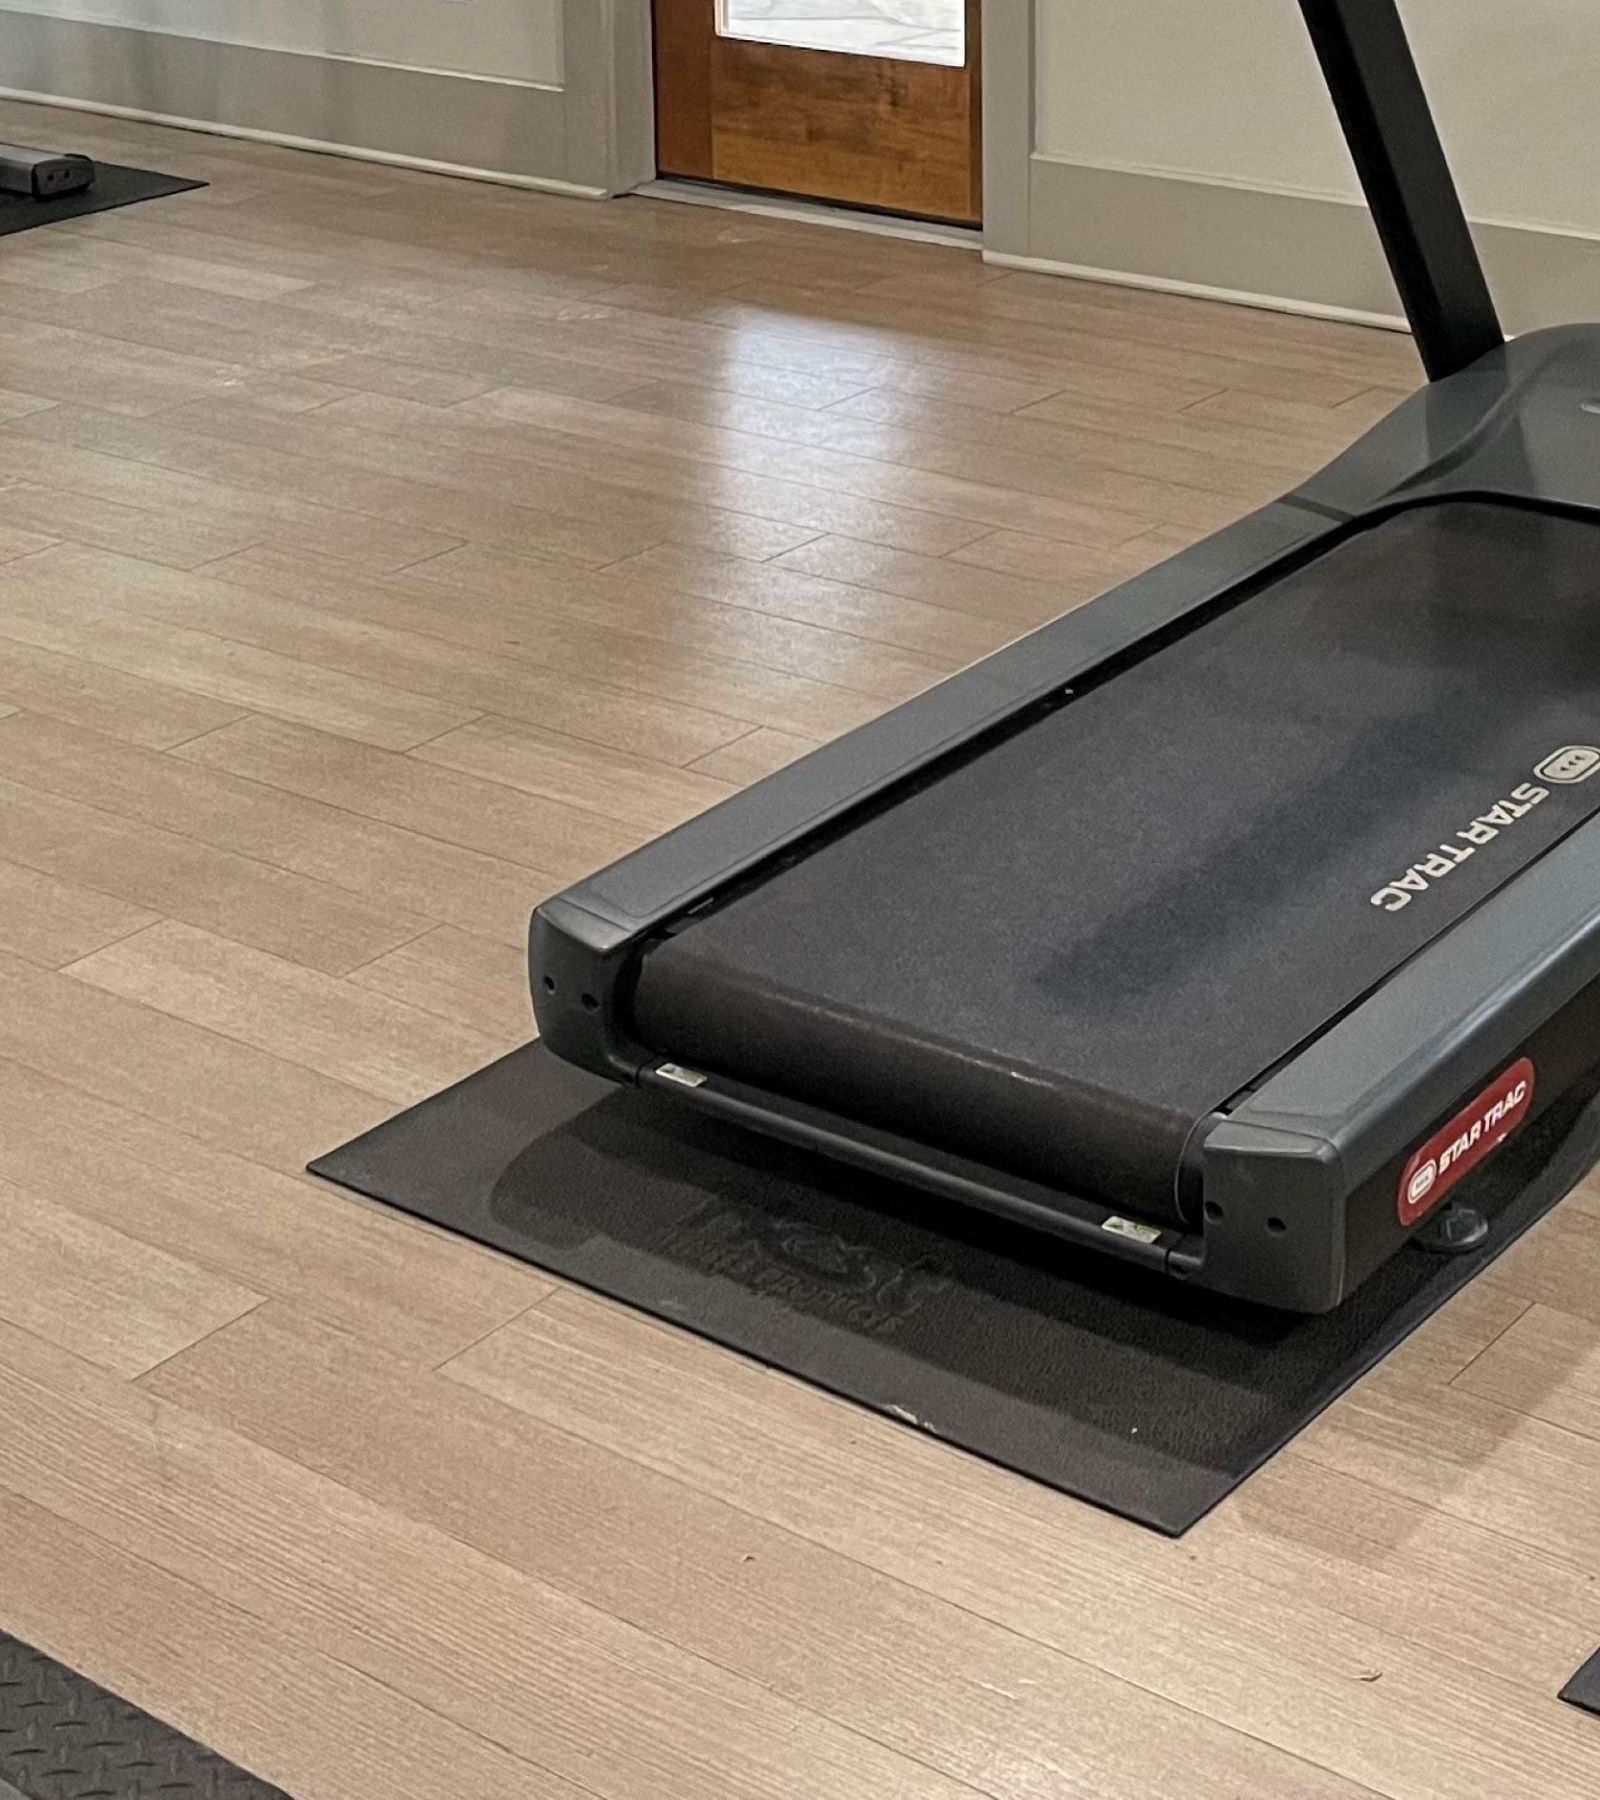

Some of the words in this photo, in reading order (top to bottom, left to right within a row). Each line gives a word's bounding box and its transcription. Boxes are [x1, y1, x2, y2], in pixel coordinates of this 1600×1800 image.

[1456, 782, 1550, 845] STAR
[1370, 844, 1476, 912] TRAC
[1438, 1119, 1482, 1175] STAR
[1482, 1080, 1527, 1132] TRAC
